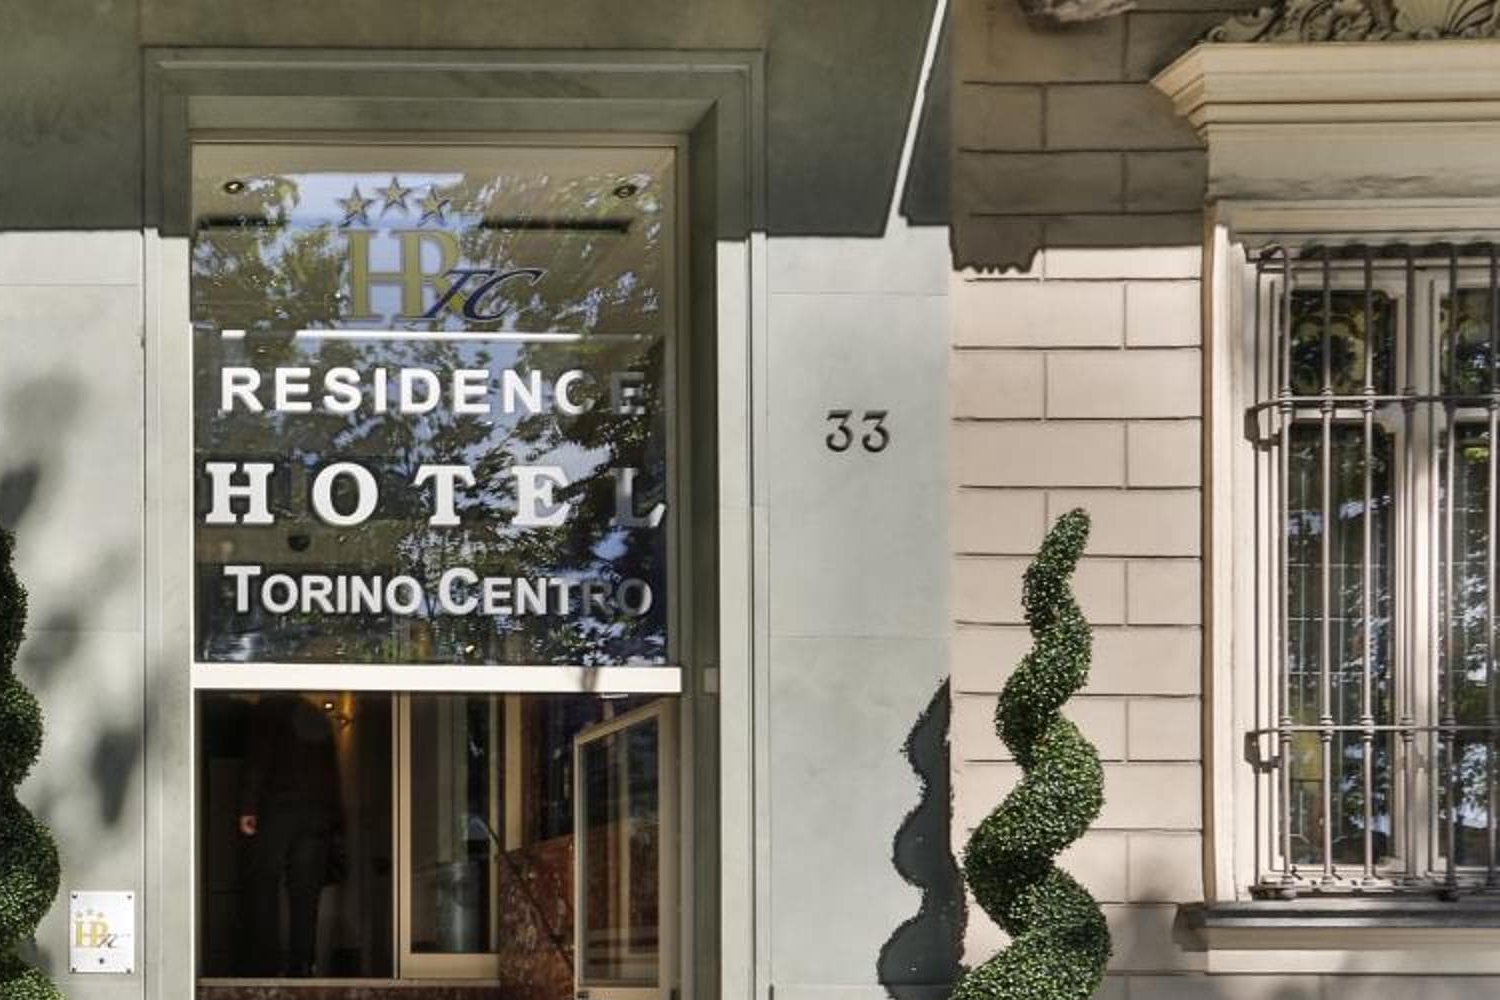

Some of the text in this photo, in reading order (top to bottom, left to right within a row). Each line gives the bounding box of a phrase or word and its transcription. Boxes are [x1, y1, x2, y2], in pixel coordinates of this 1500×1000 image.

[220, 366, 646, 416] RESIDENCE
[825, 409, 890, 453] 33
[204, 461, 665, 528] HOTEL
